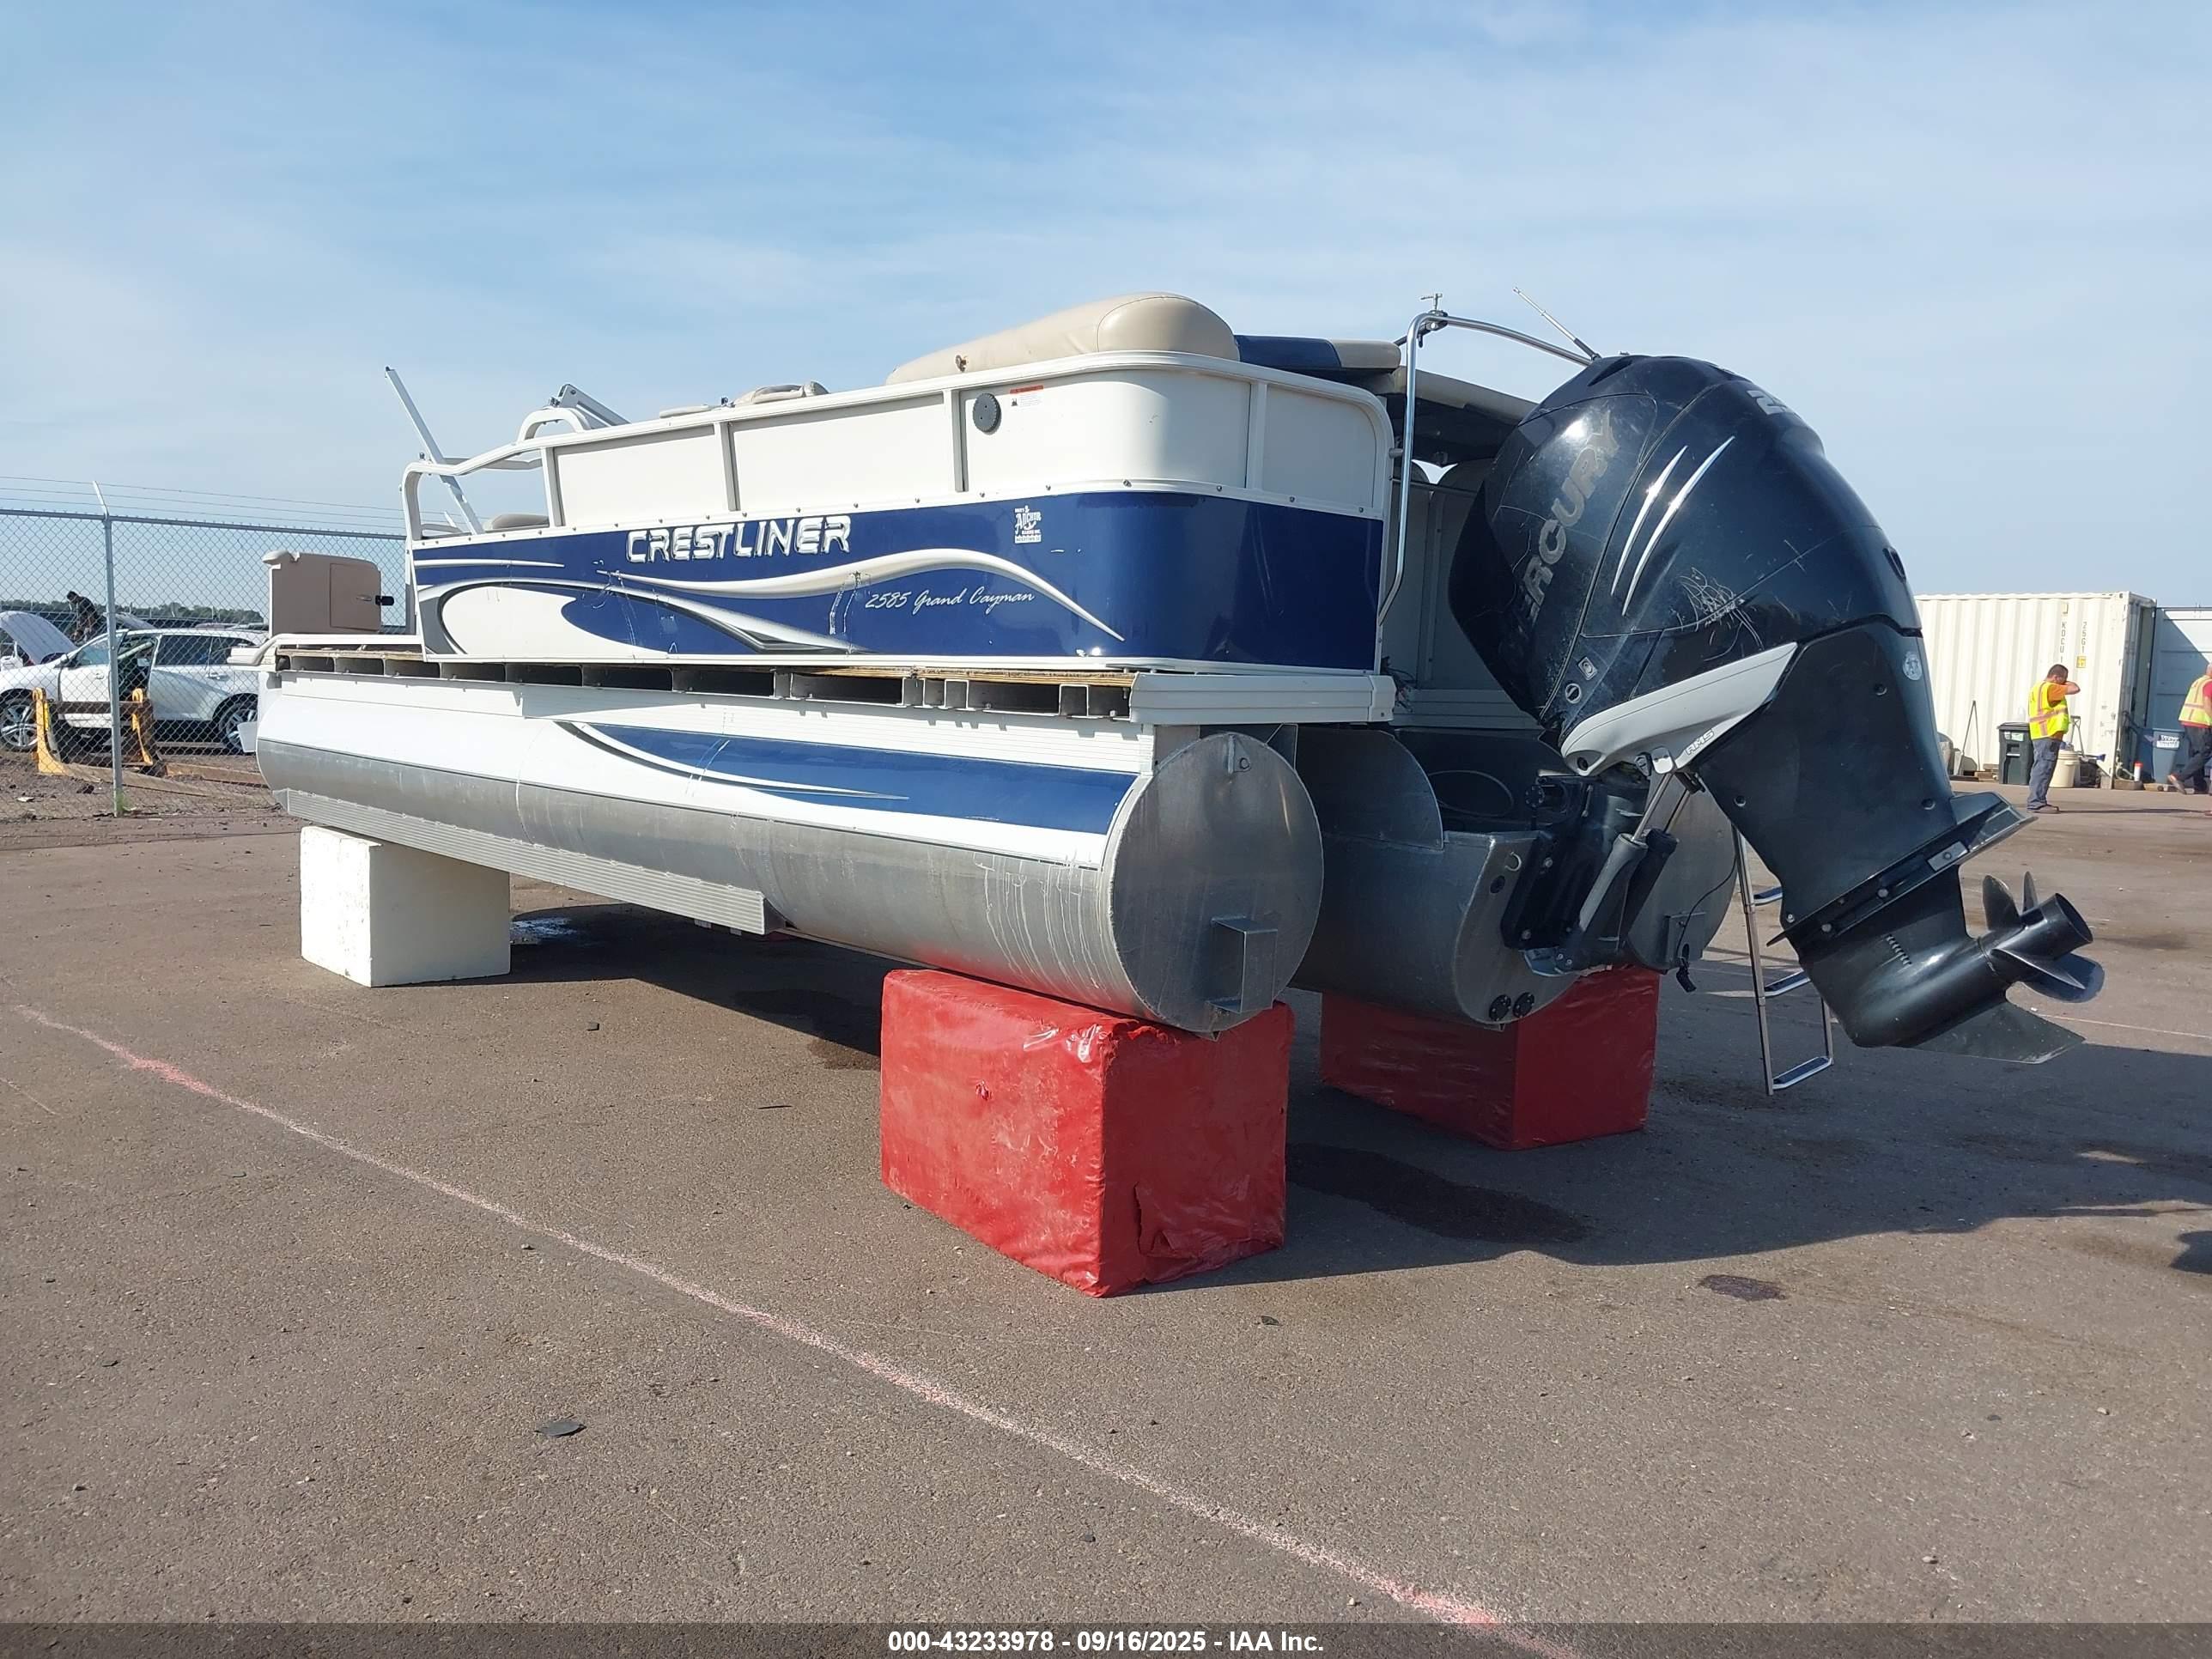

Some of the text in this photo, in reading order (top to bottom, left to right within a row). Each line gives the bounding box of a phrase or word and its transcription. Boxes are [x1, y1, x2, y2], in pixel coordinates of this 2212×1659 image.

[626, 515, 851, 563] CRESTLINER
[865, 586, 1036, 616] 2585 Grand Cayman
